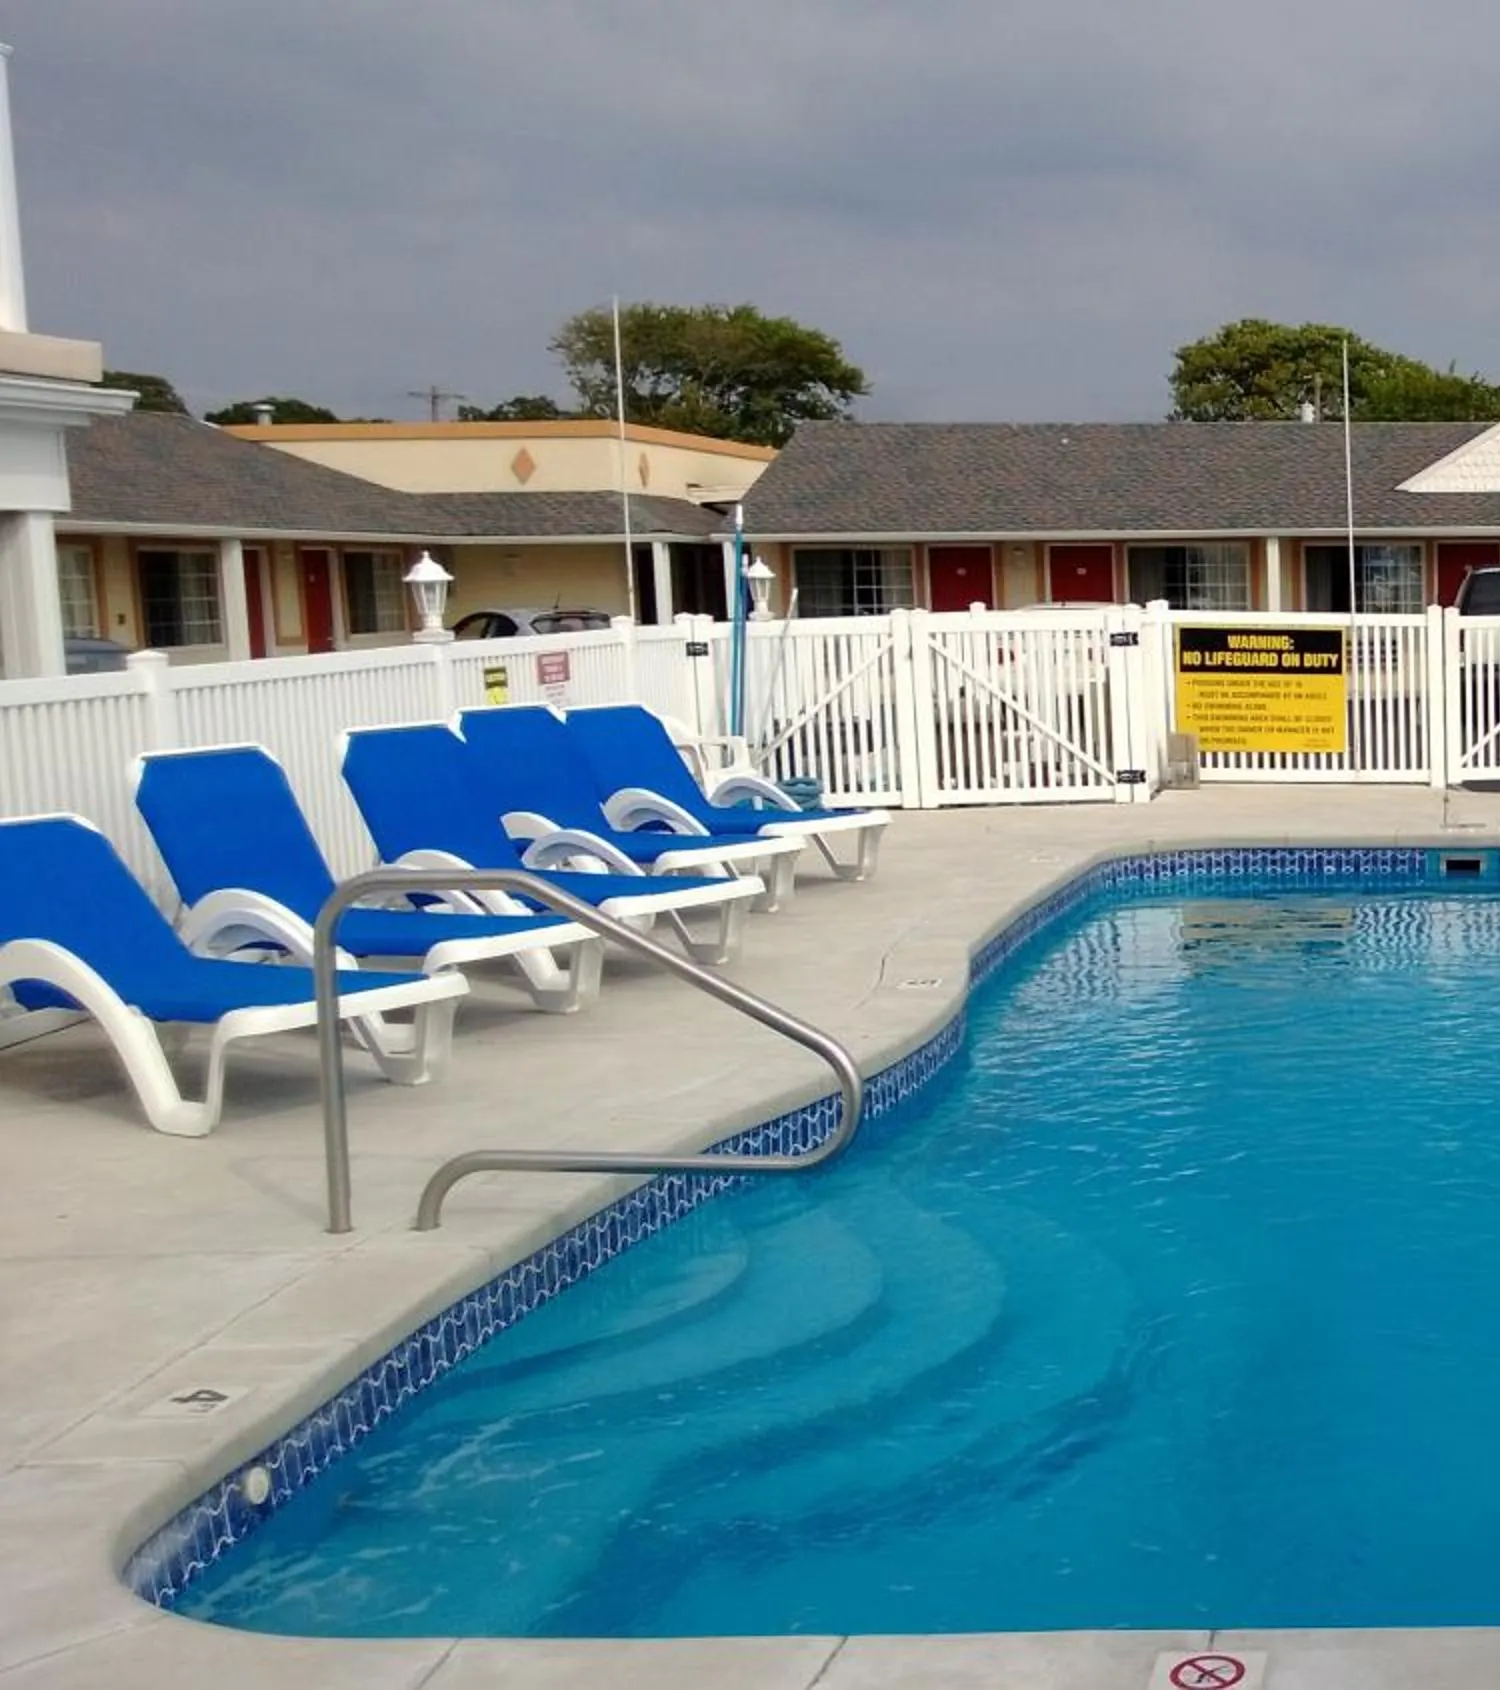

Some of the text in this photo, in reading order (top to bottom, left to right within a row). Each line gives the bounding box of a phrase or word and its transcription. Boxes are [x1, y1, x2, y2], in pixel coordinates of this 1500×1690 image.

[1227, 635, 1295, 651] WARNING:
[1183, 652, 1339, 668] NO LIFEGUARD ON DUTY
[170, 1389, 229, 1404] 4
